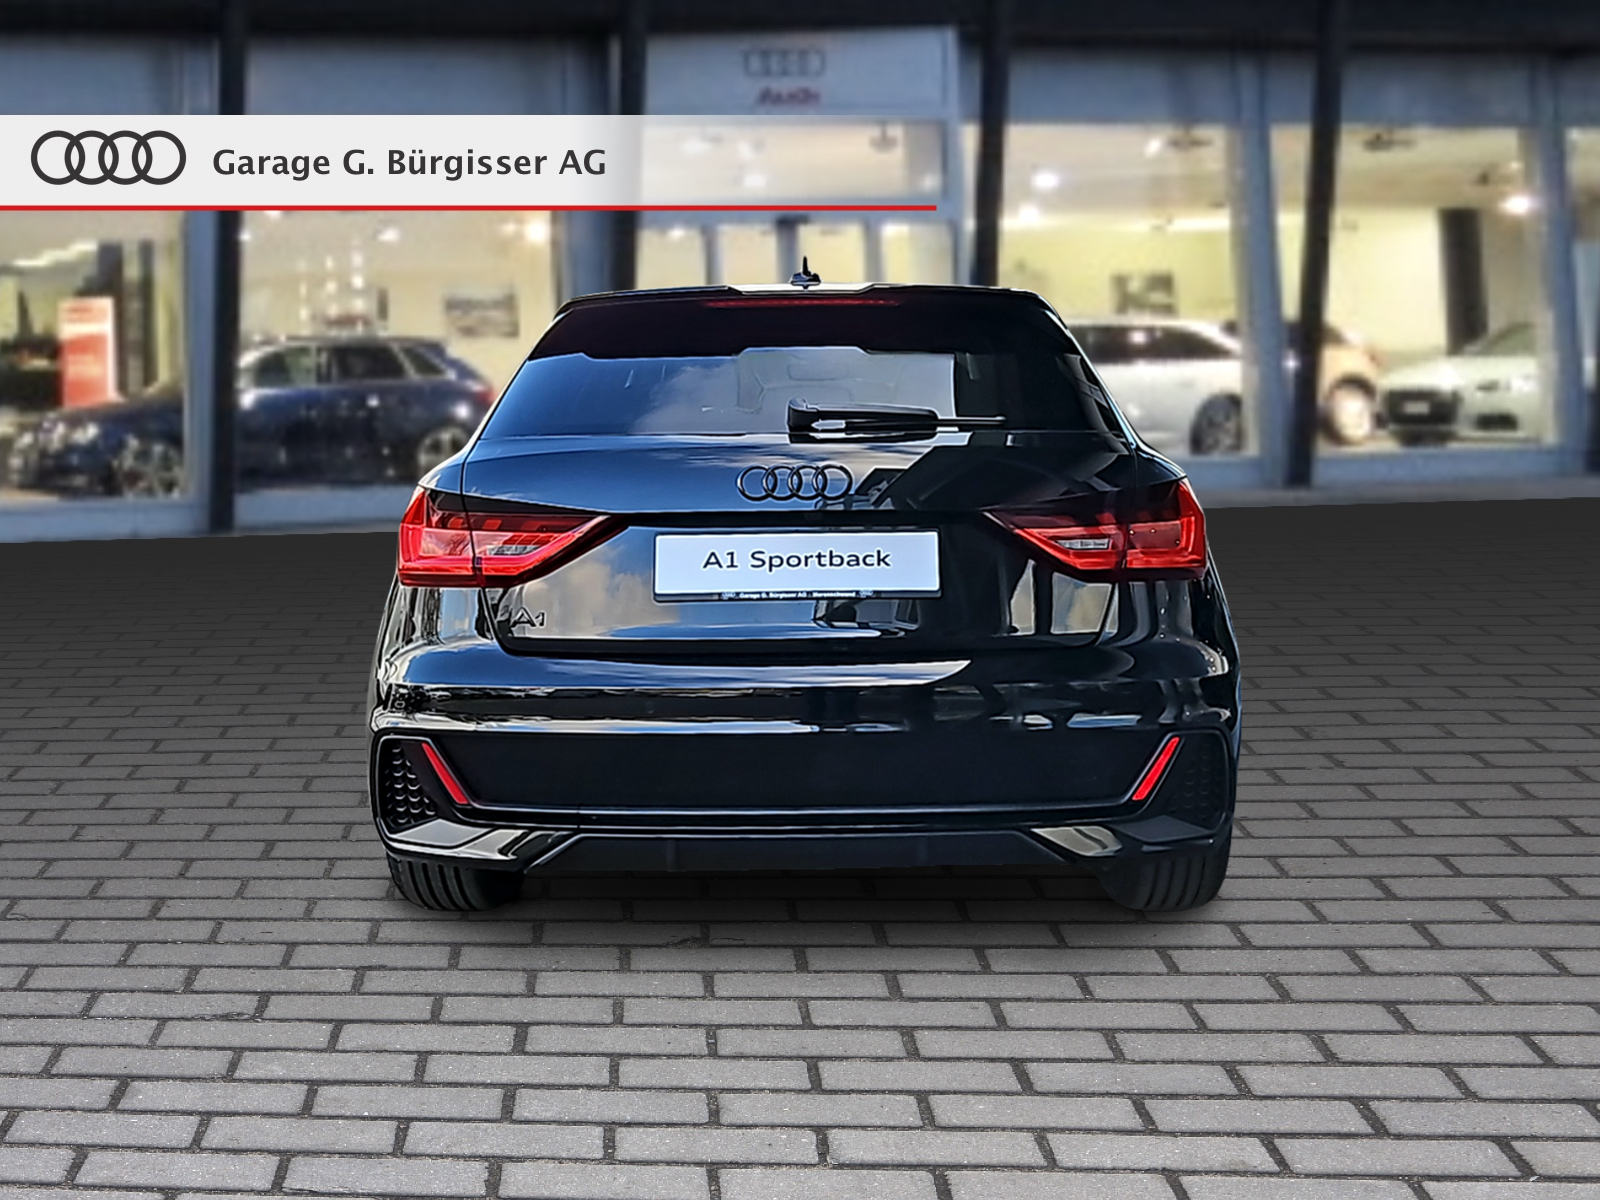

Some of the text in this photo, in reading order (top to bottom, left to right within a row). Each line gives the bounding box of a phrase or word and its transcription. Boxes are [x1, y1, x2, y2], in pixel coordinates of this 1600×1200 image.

[703, 549, 891, 572] A1 Sportback
[510, 606, 545, 627] A1
